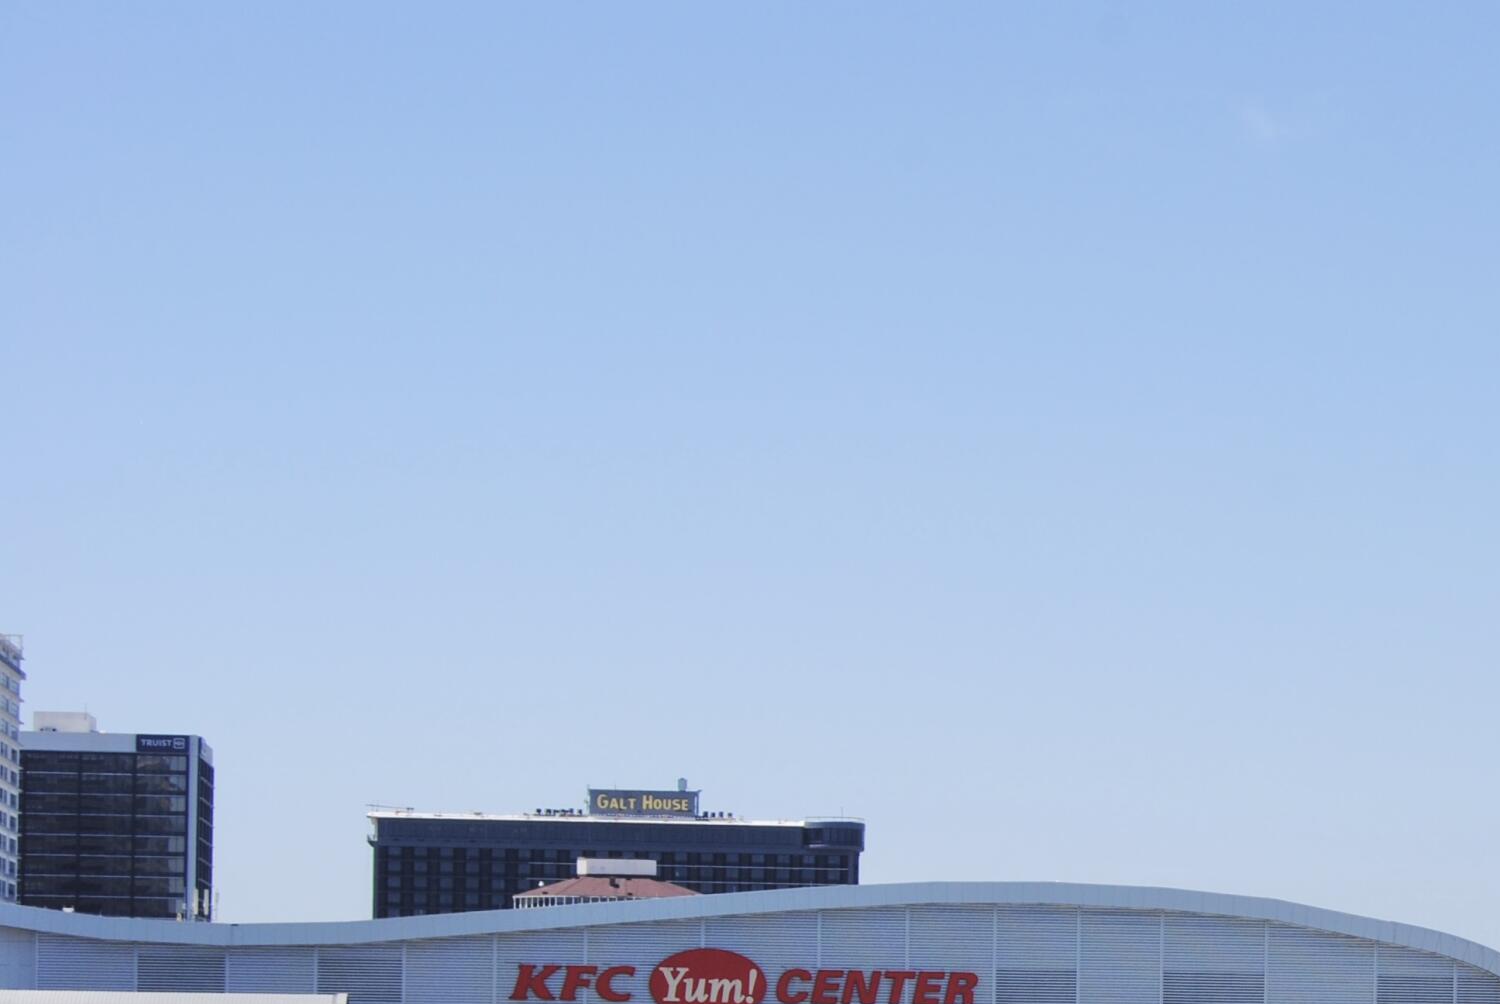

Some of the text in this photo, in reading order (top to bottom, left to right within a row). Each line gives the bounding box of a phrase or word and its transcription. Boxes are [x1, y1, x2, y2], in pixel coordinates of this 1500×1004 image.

[141, 738, 173, 747] TRUIST
[508, 964, 636, 1002] KFC
[659, 967, 758, 1004] Yum!
